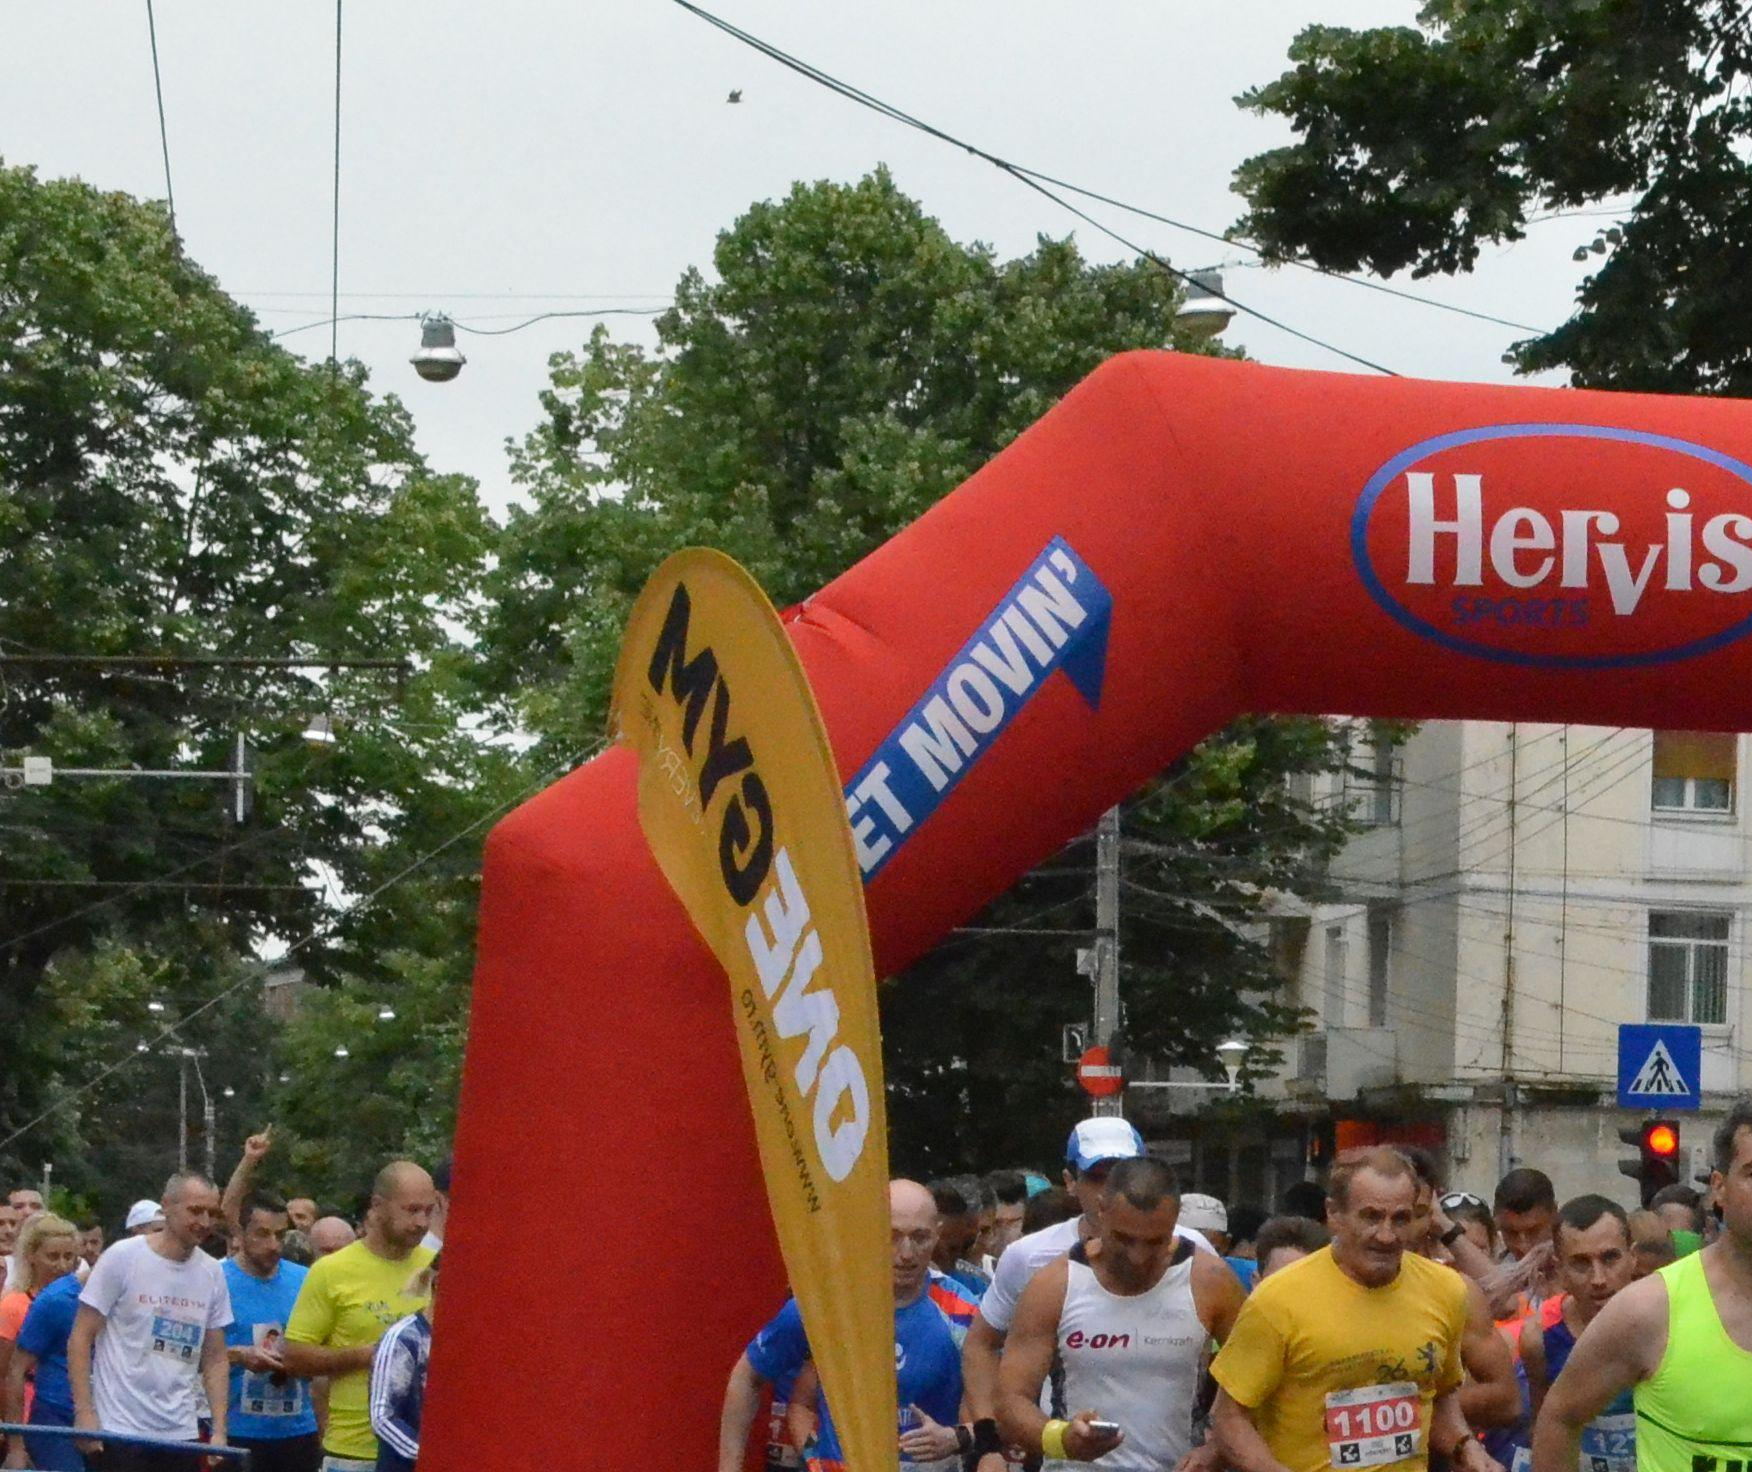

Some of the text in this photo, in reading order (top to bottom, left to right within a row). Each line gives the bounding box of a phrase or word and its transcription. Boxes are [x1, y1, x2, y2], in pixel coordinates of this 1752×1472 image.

[1452, 597, 1589, 628] SPORTS
[848, 548, 1089, 872] ET MOVIN'
[159, 1319, 194, 1340] 204
[1334, 1402, 1414, 1436] 1100
[1593, 1431, 1635, 1455] 12
